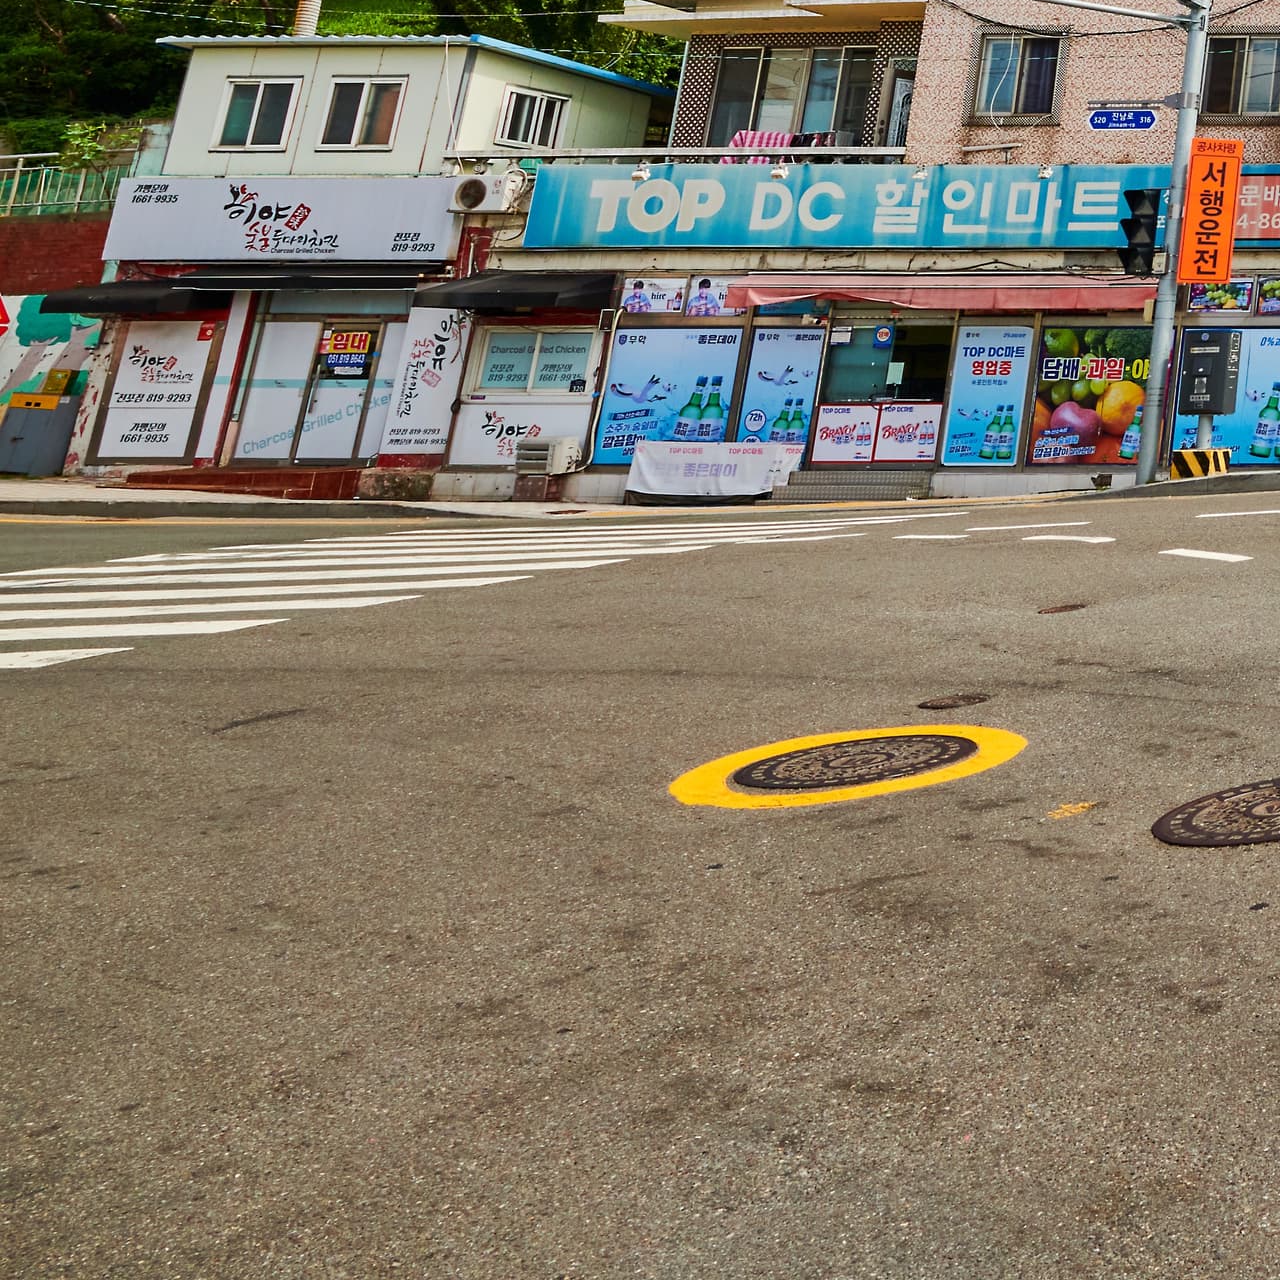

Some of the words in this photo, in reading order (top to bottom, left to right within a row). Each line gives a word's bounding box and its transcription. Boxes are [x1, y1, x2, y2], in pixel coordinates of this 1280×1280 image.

[1093, 116, 1107, 124] 320
[1112, 111, 1134, 121] 진남로
[1196, 141, 1237, 154] 공사차량
[133, 184, 170, 193] 가맹문의
[131, 194, 179, 203] 1661-9935
[588, 179, 726, 233] TOP
[749, 181, 845, 232] DC
[872, 179, 1122, 234] 할인마트
[1193, 161, 1227, 276] 서행운전
[393, 232, 421, 242] 전포점
[391, 242, 436, 253] 819-9293
[333, 333, 370, 350] 임대
[628, 335, 647, 344] 무학
[698, 335, 737, 344] 좋은데이
[491, 345, 526, 354] Charcoal
[527, 345, 553, 354] Grlled
[555, 345, 586, 354] Chicken
[963, 346, 985, 358] TOP
[988, 346, 1025, 358] DC마트
[972, 360, 1012, 376] 영업중
[488, 373, 528, 381] 819-9293
[539, 373, 582, 382] 1661-9935
[146, 393, 192, 402] 819-9293
[750, 413, 763, 421] 72h
[243, 427, 296, 455] Charcoa
[302, 411, 343, 433] Grilled
[409, 428, 441, 436] 819-9293
[605, 423, 630, 434] 소주가
[820, 424, 857, 441] BRAVO!
[882, 423, 920, 439] BRAVO!
[120, 433, 169, 442] 1661-9935
[413, 438, 448, 446] 1661-9935
[683, 463, 738, 478] 좋은데이
